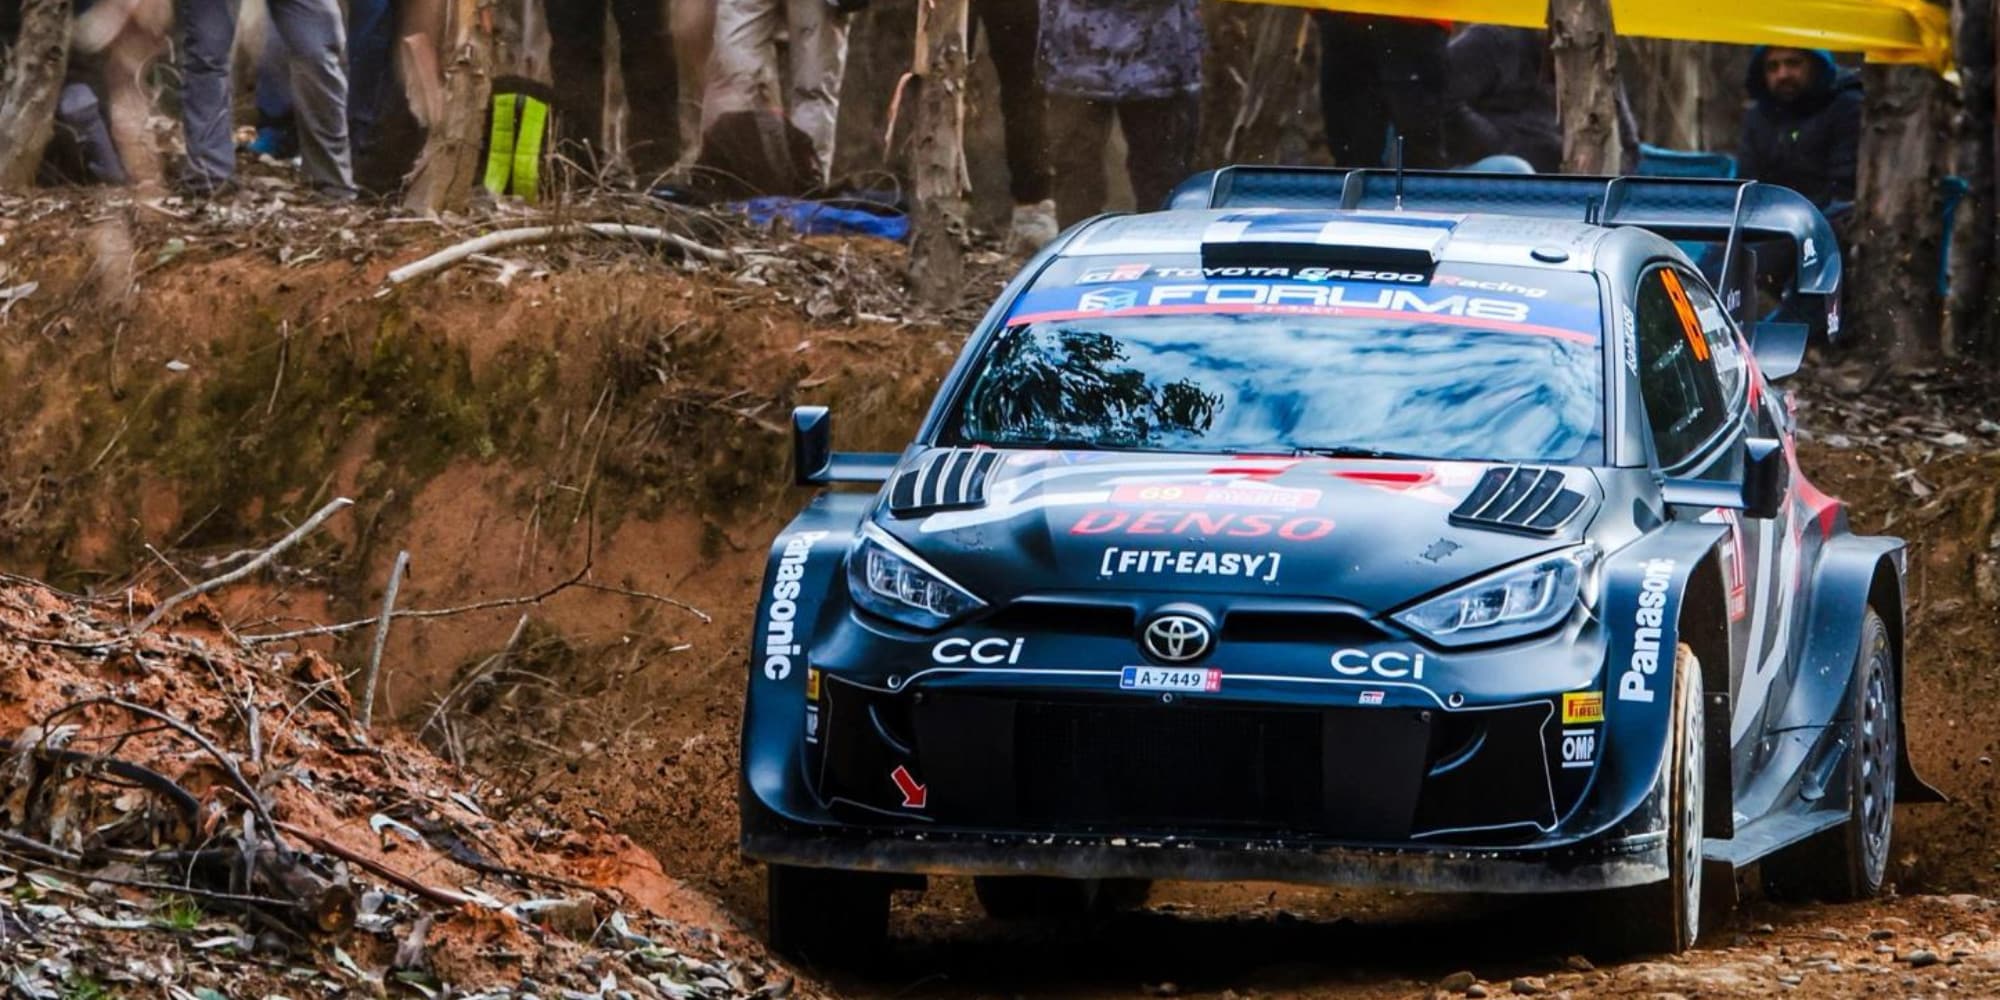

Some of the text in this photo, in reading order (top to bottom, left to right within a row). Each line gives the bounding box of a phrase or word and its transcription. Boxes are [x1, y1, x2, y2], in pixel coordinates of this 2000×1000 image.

[1154, 267, 1290, 278] TOYOTA
[1296, 267, 1425, 283] GAZOO
[1430, 274, 1549, 298] Racing
[1148, 284, 1531, 322] FORUM8
[1068, 509, 1336, 541] DENSO
[764, 530, 830, 681] Panasonic
[1140, 671, 1201, 687] A-7449
[1562, 735, 1595, 761] OMP
